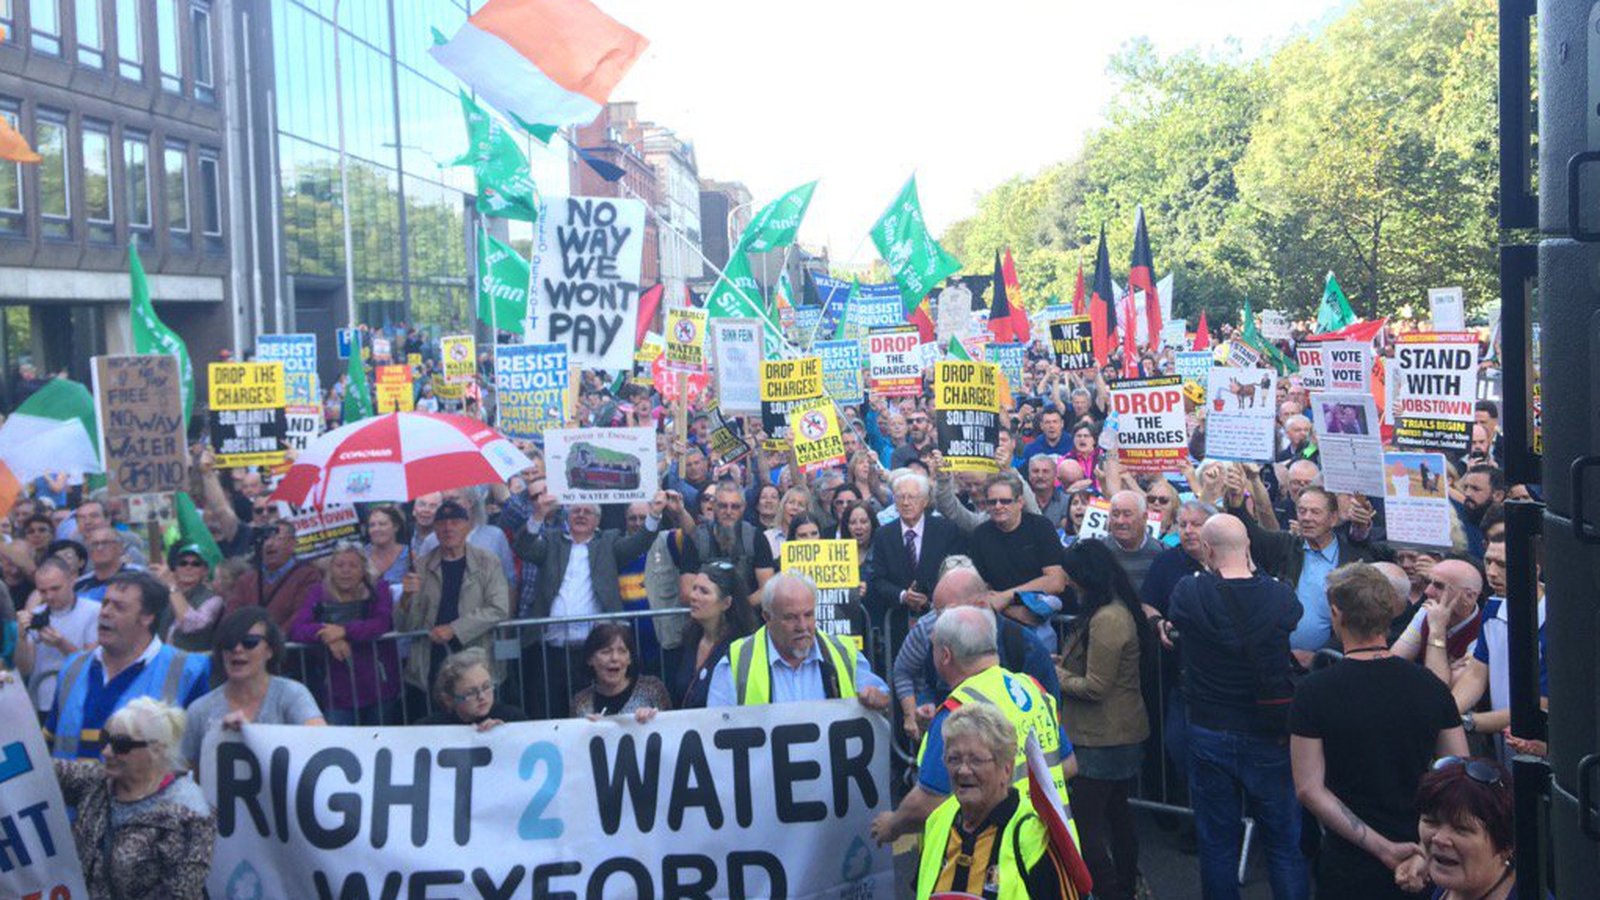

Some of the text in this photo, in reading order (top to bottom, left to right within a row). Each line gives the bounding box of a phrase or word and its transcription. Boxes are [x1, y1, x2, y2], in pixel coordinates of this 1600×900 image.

[567, 197, 617, 227] NO
[557, 225, 631, 256] WAY
[563, 254, 621, 280] WE
[544, 277, 638, 311] WONT
[549, 312, 624, 356] PAY
[1062, 324, 1079, 339] WE
[259, 343, 314, 358] RESIST
[871, 336, 918, 353] DROP
[1053, 336, 1091, 354] WON'T
[497, 352, 566, 371] RESIST
[886, 355, 905, 363] THE
[1061, 355, 1089, 369] PAY!
[1301, 351, 1322, 366] DR
[1332, 351, 1361, 362] VOTE
[1400, 348, 1471, 370] STAND
[215, 365, 276, 384] DROP THE
[766, 359, 817, 379] DROP THE
[873, 365, 919, 376] CHARGES
[942, 365, 995, 385] DROP THE
[1332, 370, 1361, 381] VOTE
[497, 370, 566, 389] REVOLT
[767, 379, 816, 398] CHARGES!
[1407, 374, 1460, 396] WITH
[216, 387, 276, 406] CHARGES!
[943, 387, 995, 407] CHARGES!
[1114, 391, 1180, 414] DROP
[1402, 399, 1471, 415] JOBSTOWN
[947, 411, 994, 427] SOLIDARITY
[1135, 416, 1162, 428] THE
[962, 427, 985, 441] WITH
[1118, 430, 1184, 444] CHARGES
[106, 436, 176, 458] WATER
[795, 435, 842, 454] WATER
[948, 440, 994, 456] JOBSTOWN
[799, 447, 843, 464] CHARGES
[788, 544, 850, 562] DROP THE
[217, 718, 879, 849] RIGHT 2 WATER
